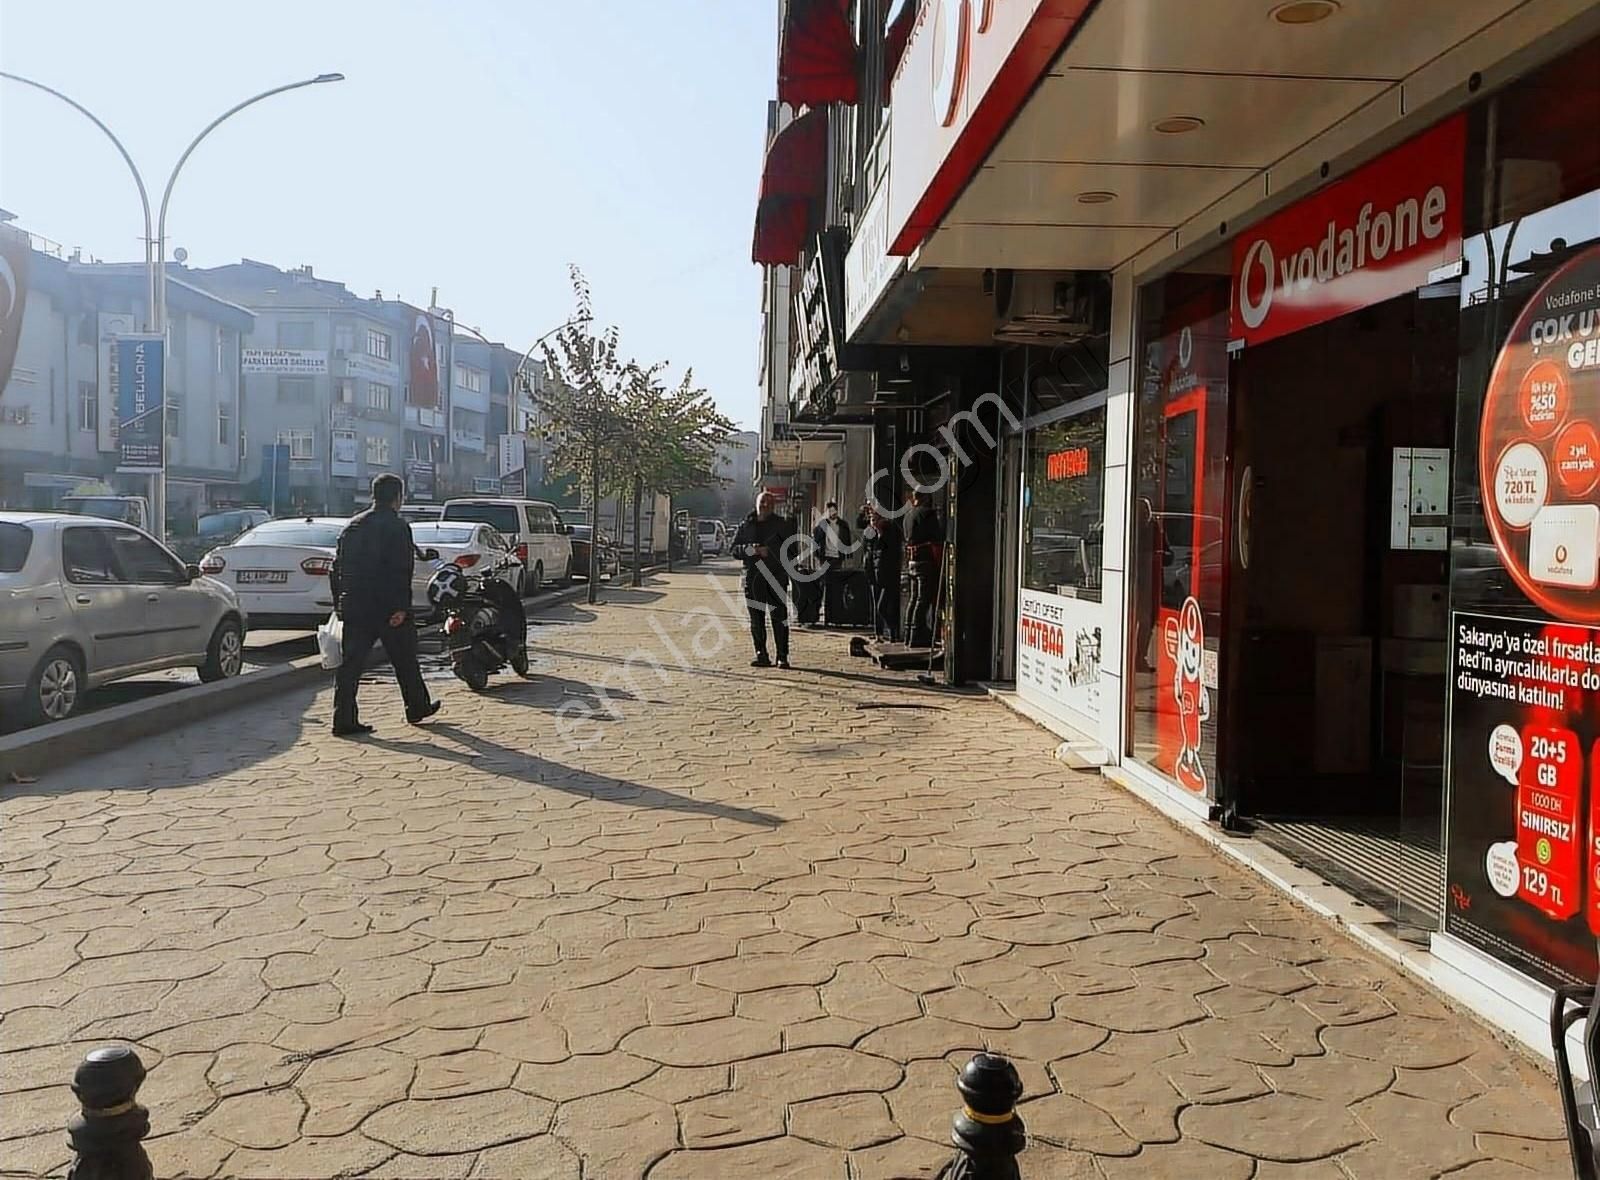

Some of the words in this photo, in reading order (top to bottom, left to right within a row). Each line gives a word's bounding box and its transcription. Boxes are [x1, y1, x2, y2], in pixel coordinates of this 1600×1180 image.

[1280, 185, 1447, 297] vodafone
[1546, 288, 1595, 310] Vodafone
[1531, 313, 1575, 354] ÇOK
[1579, 308, 1600, 337] U
[135, 342, 145, 414] BELLONA
[1505, 480, 1523, 494] 720
[1524, 480, 1537, 494] TL
[1021, 617, 1064, 659] MATBAA
[1459, 624, 1521, 655] Sakarya'ya
[1523, 632, 1549, 657] özel
[1458, 648, 1493, 672] Red'in
[1494, 658, 1579, 687] ayrıcalıklarla
[1457, 671, 1516, 698] dünyasına
[1518, 681, 1564, 710] katılın!
[1530, 735, 1566, 764] 20+5
[1537, 762, 1557, 787] GB
[1521, 810, 1570, 842] SINIRSIZ
[1523, 866, 1548, 897] 129
[1550, 885, 1564, 906] TL
